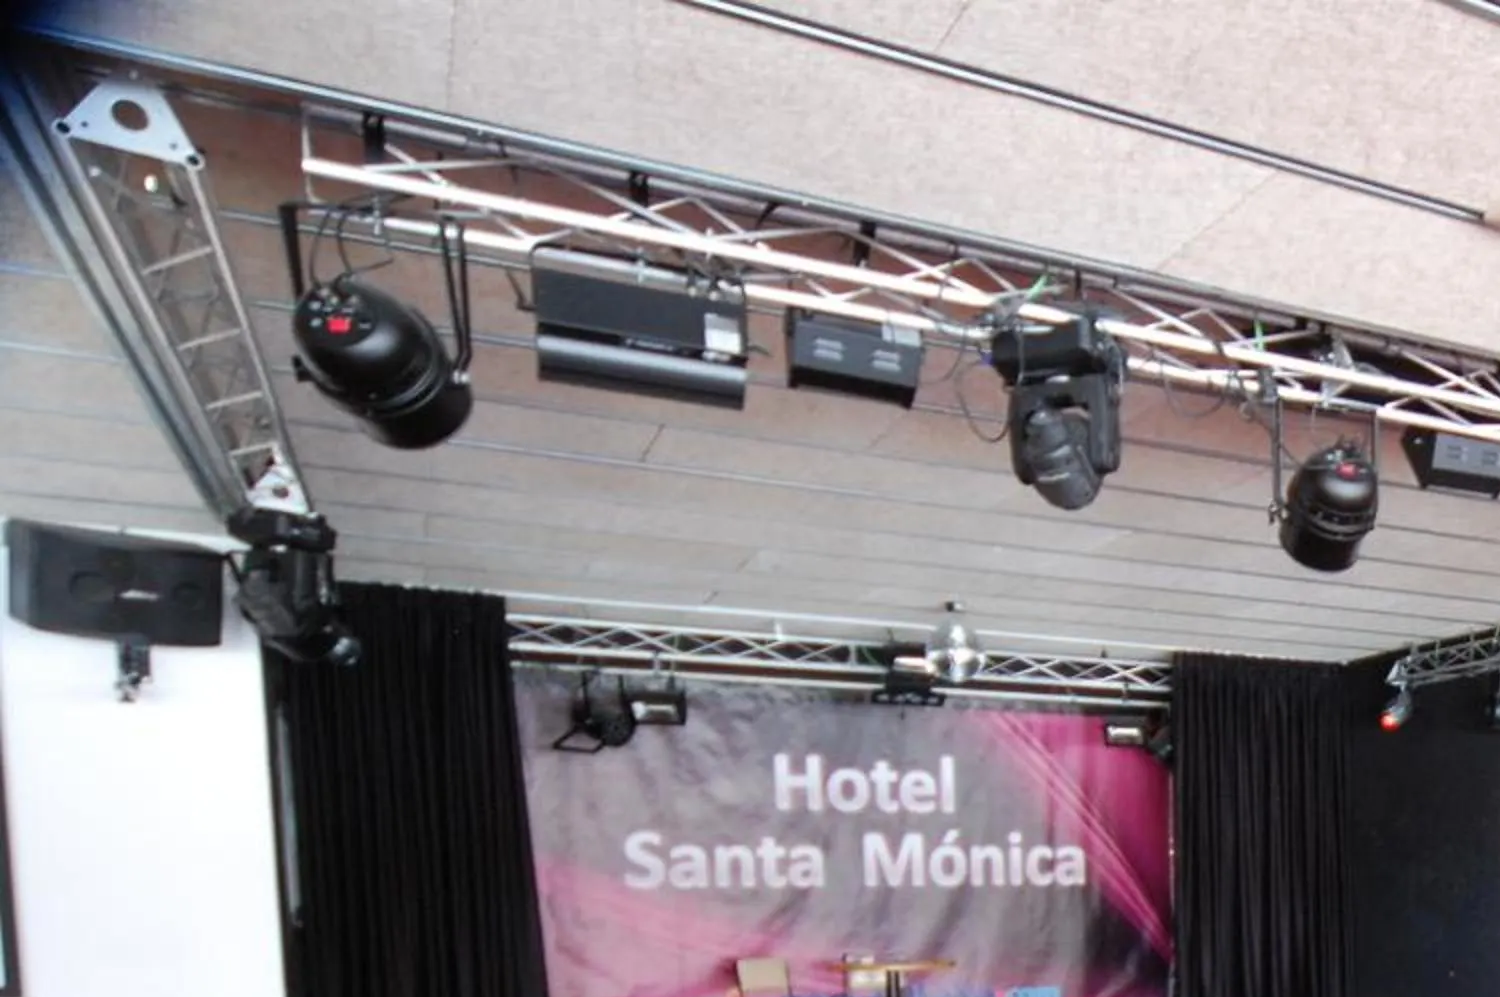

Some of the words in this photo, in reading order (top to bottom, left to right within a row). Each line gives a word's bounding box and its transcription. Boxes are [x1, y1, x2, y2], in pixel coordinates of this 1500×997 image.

[772, 753, 956, 814] Hotel
[622, 830, 825, 889] Santa
[862, 829, 1086, 888] Mónica
